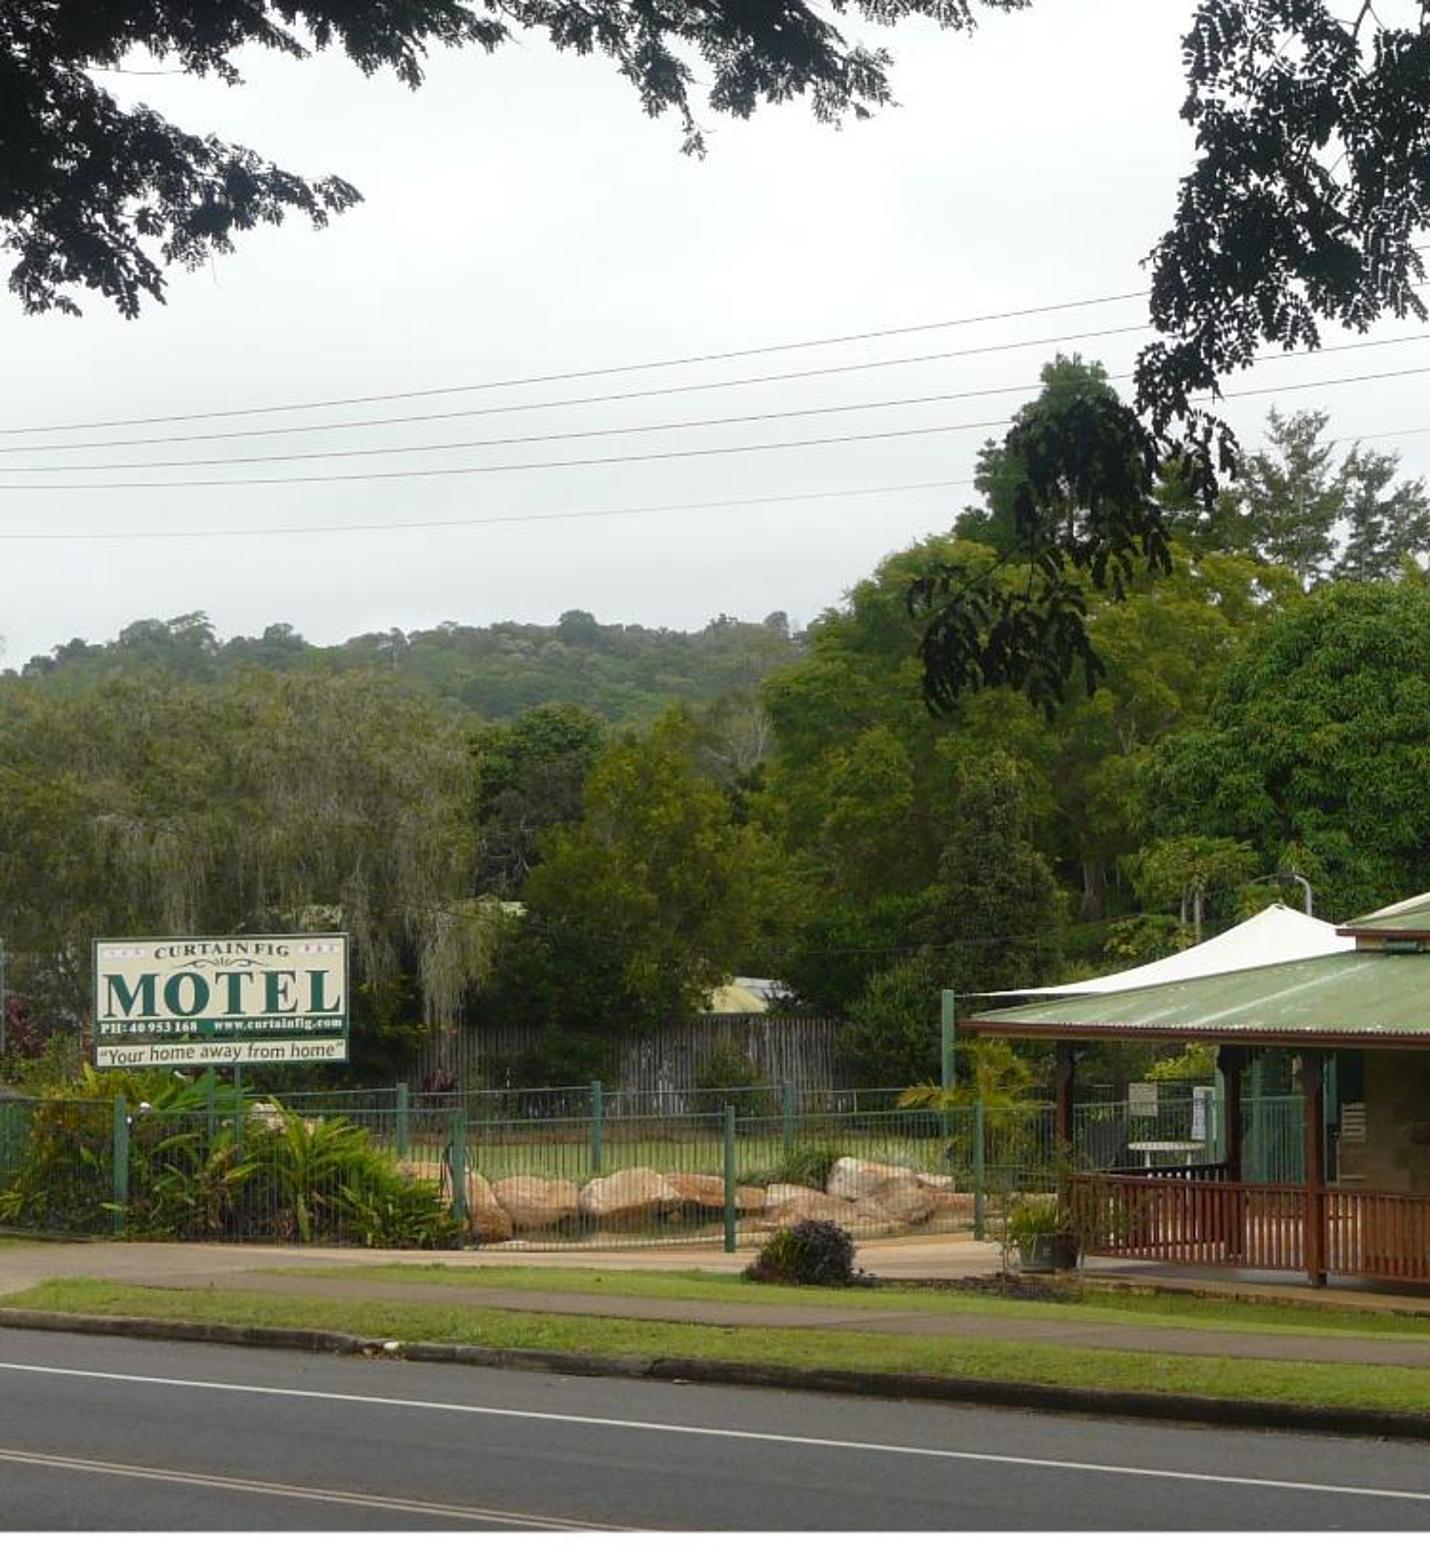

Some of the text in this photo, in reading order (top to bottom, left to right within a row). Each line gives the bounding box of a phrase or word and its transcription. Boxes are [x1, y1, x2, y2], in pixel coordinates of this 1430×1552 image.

[154, 942, 290, 960] CURTAIN FIG
[103, 969, 340, 1017] MOTEL
[129, 1021, 146, 1034] 40
[148, 1020, 172, 1033] 953
[174, 1020, 198, 1032] 168
[213, 1017, 343, 1031] www.curtainfig.com
[150, 1045, 195, 1062] home
[200, 1045, 243, 1062] away
[248, 1044, 285, 1059] from
